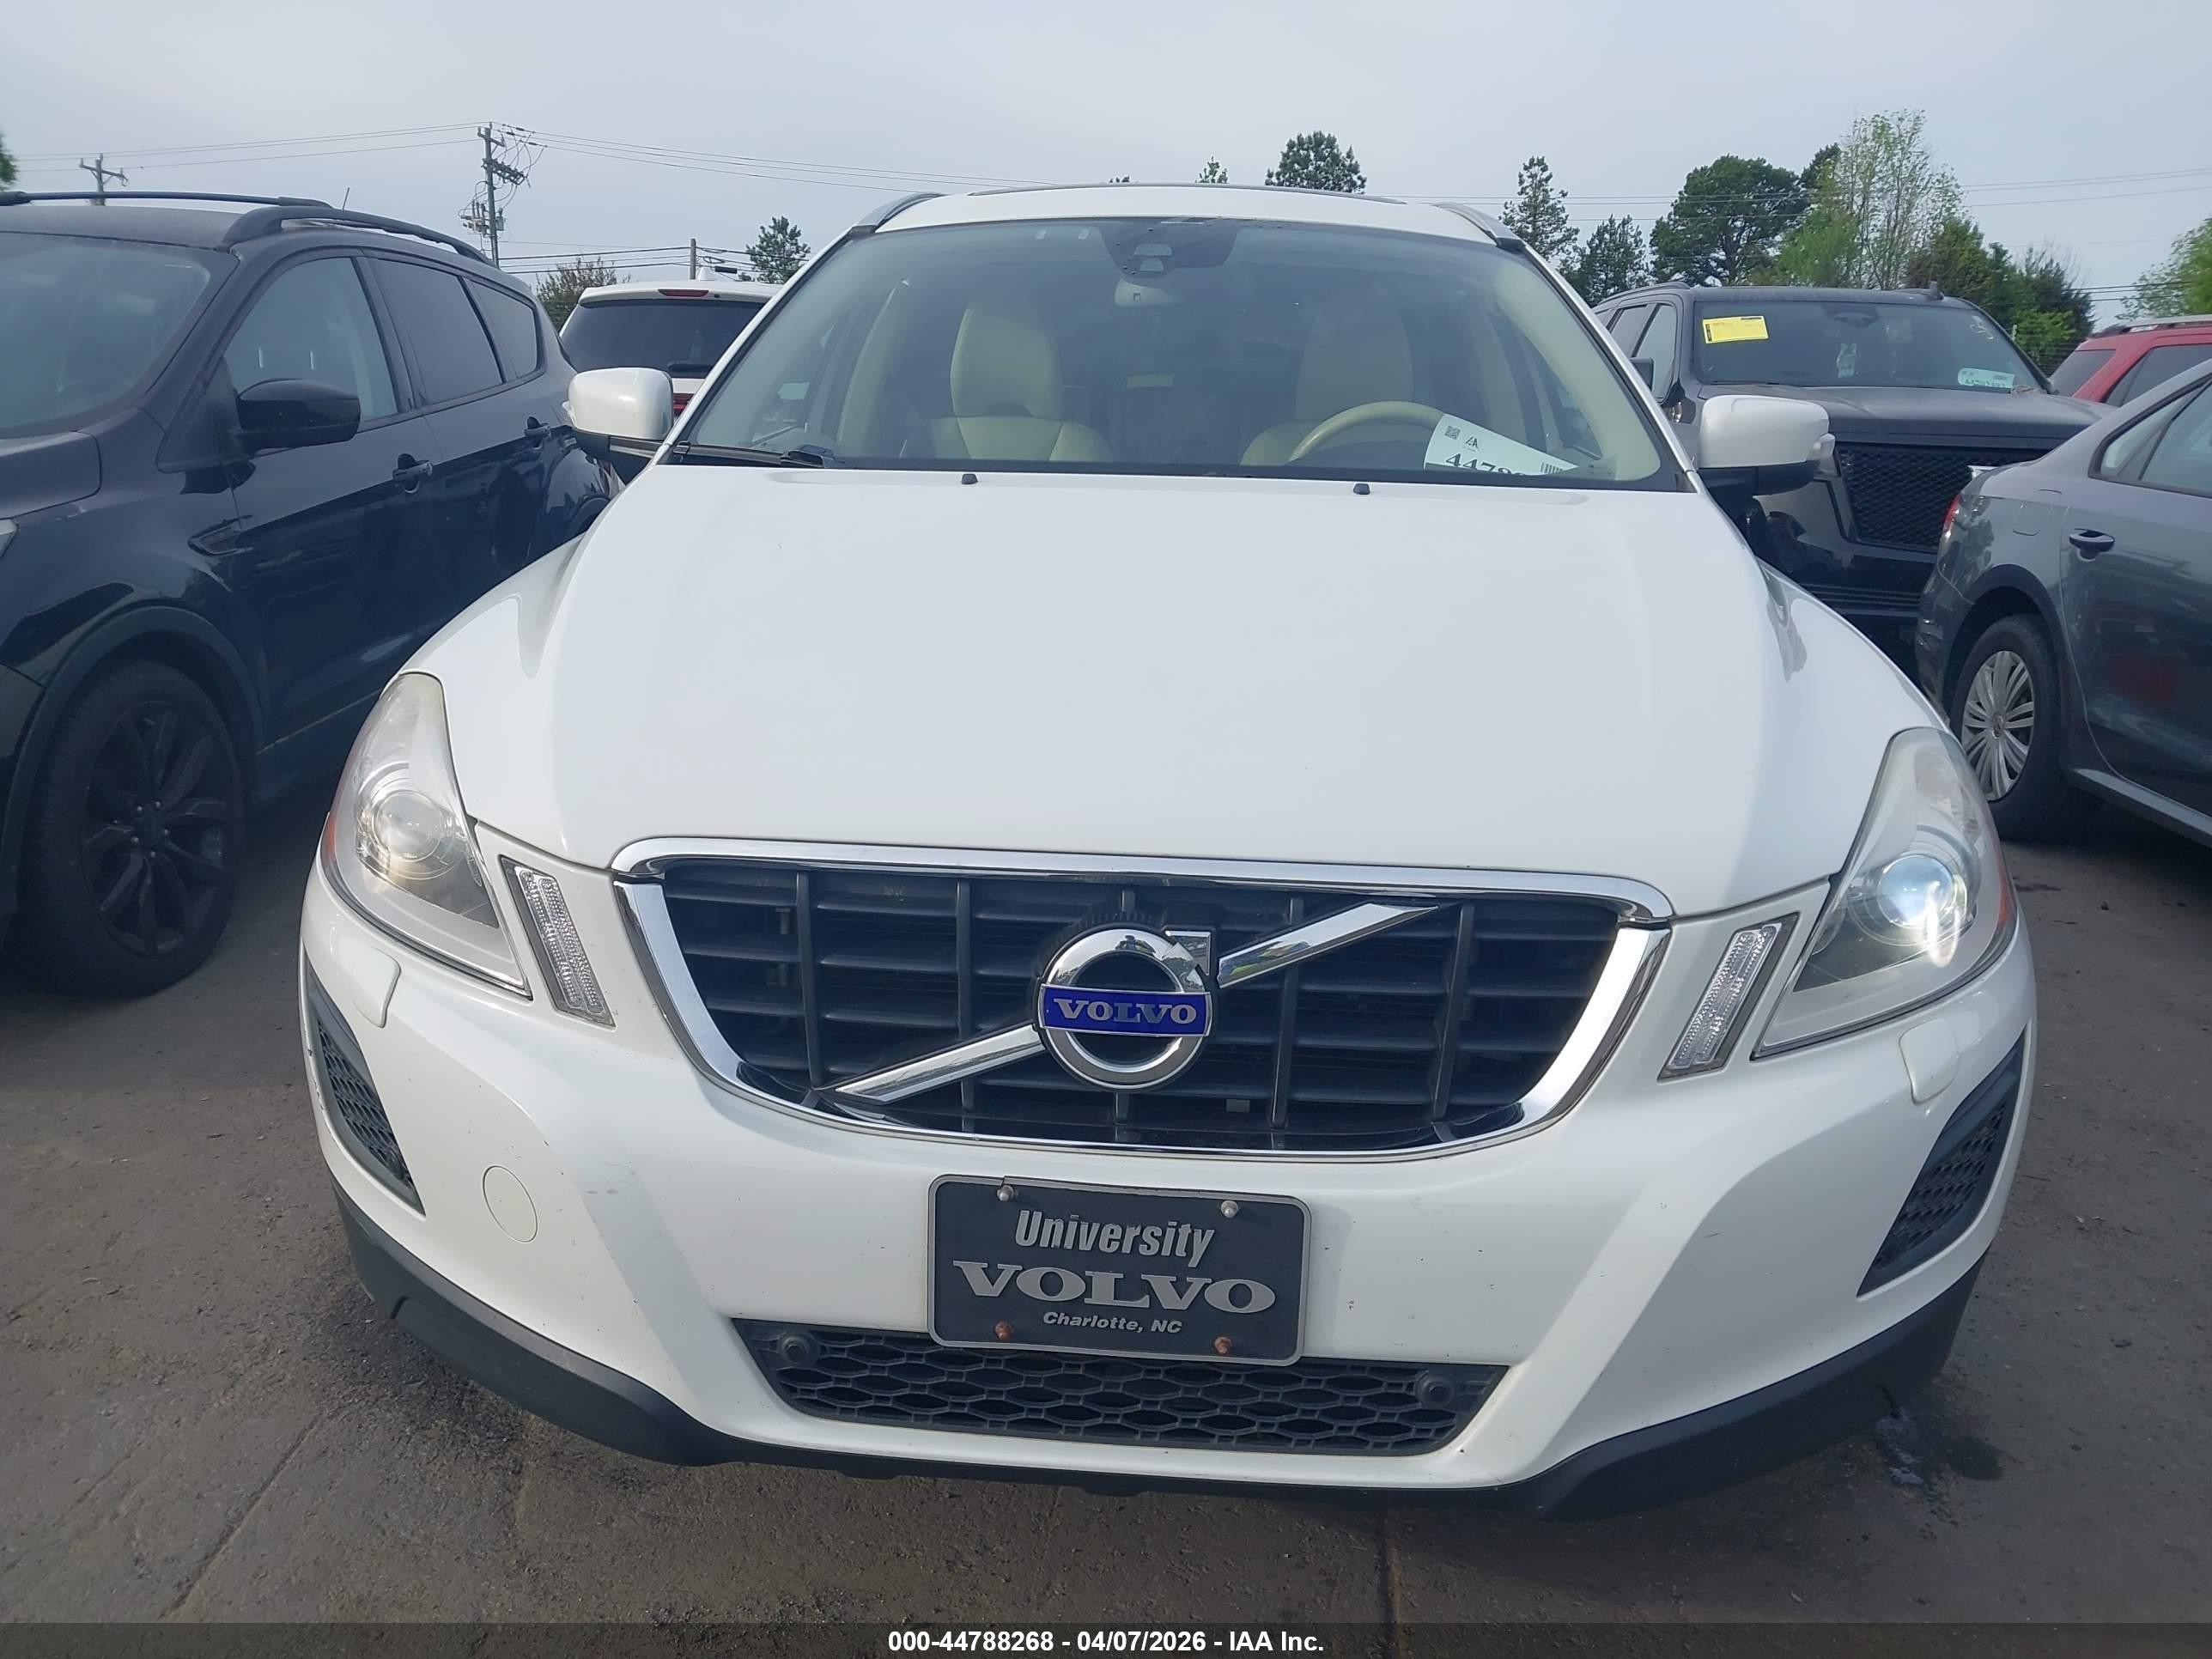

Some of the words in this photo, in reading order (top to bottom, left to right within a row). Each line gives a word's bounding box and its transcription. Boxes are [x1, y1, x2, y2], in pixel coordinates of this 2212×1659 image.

[1054, 998, 1197, 1024] VOLVO
[1015, 1210, 1216, 1268] University
[953, 1261, 1275, 1314] VOLVO
[1042, 1311, 1143, 1334] Charlotte,
[1152, 1319, 1182, 1334] NC
